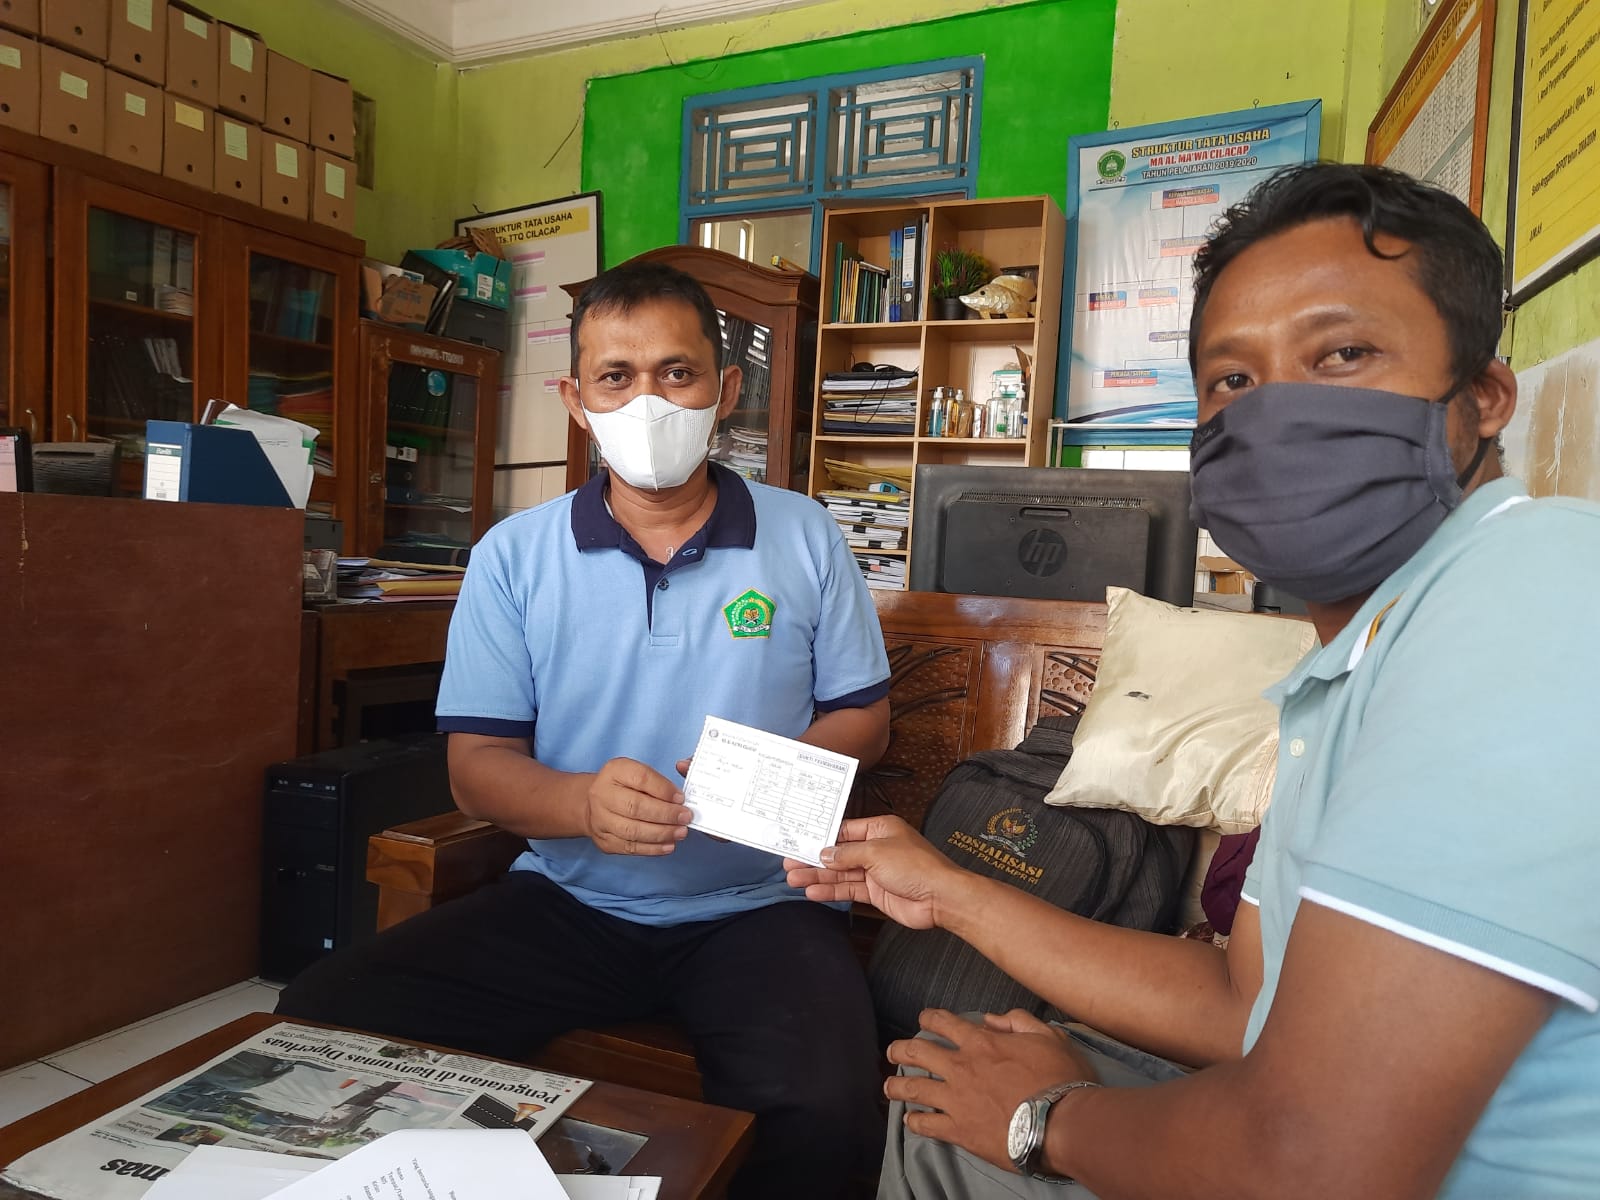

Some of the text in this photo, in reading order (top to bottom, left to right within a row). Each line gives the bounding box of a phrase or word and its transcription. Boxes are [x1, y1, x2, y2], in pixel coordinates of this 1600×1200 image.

[1131, 127, 1271, 158] STRUKTUR TATA USAHA
[1142, 156, 1258, 179] TAHUN PELAJARAN 2019/2020
[1150, 145, 1250, 167] MA AL MA'WA CILACAP
[524, 218, 542, 230] TATA
[544, 212, 573, 225] USAHA
[509, 232, 524, 243] TTQ
[526, 225, 561, 239] CILACAP
[1023, 529, 1062, 577] hp
[947, 838, 978, 855] EMPAT
[977, 852, 1005, 871] PILAR
[1005, 866, 1028, 881] MPR
[1027, 876, 1039, 885] RI
[951, 831, 1044, 878] SOSIALISASI
[262, 1036, 345, 1061] Diperluas
[345, 1053, 432, 1079] Banyumas
[435, 1070, 457, 1082] di
[458, 1074, 562, 1104] Pengetatan
